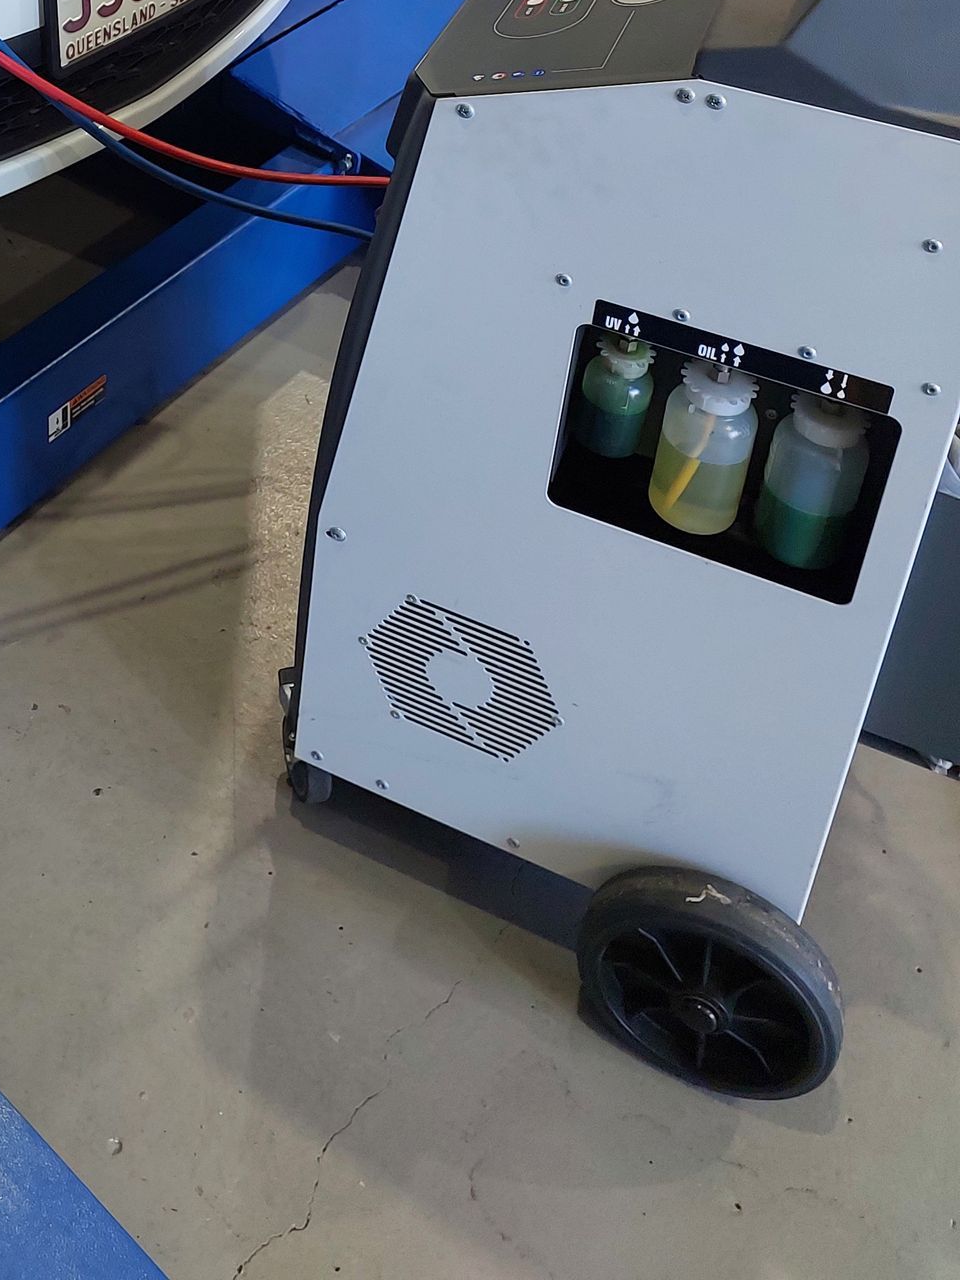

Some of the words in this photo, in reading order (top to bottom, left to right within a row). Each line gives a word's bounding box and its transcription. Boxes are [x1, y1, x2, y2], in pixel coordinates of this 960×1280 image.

[65, 3, 156, 61] QUEENSLAND
[604, 315, 622, 331] UV
[697, 344, 717, 361] OIL
